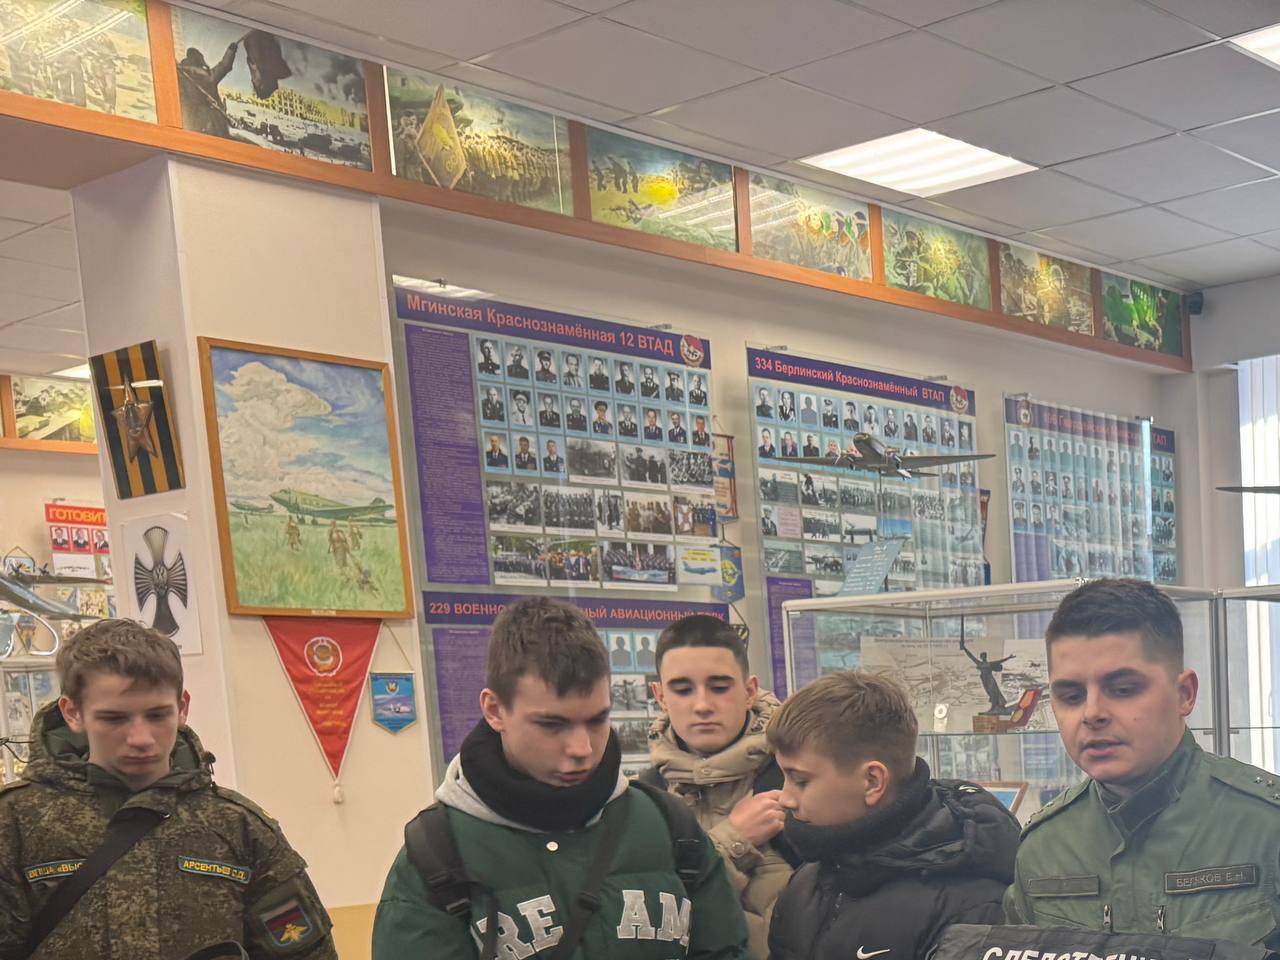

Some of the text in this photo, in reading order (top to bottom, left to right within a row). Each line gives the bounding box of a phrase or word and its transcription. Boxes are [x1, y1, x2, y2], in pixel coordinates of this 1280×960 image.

[406, 293, 675, 357] Мгинская Краснознамённая 12 ВТАД
[755, 357, 945, 402] 334 Берлинский Краснознамённый ВТАП
[429, 602, 451, 615] 229
